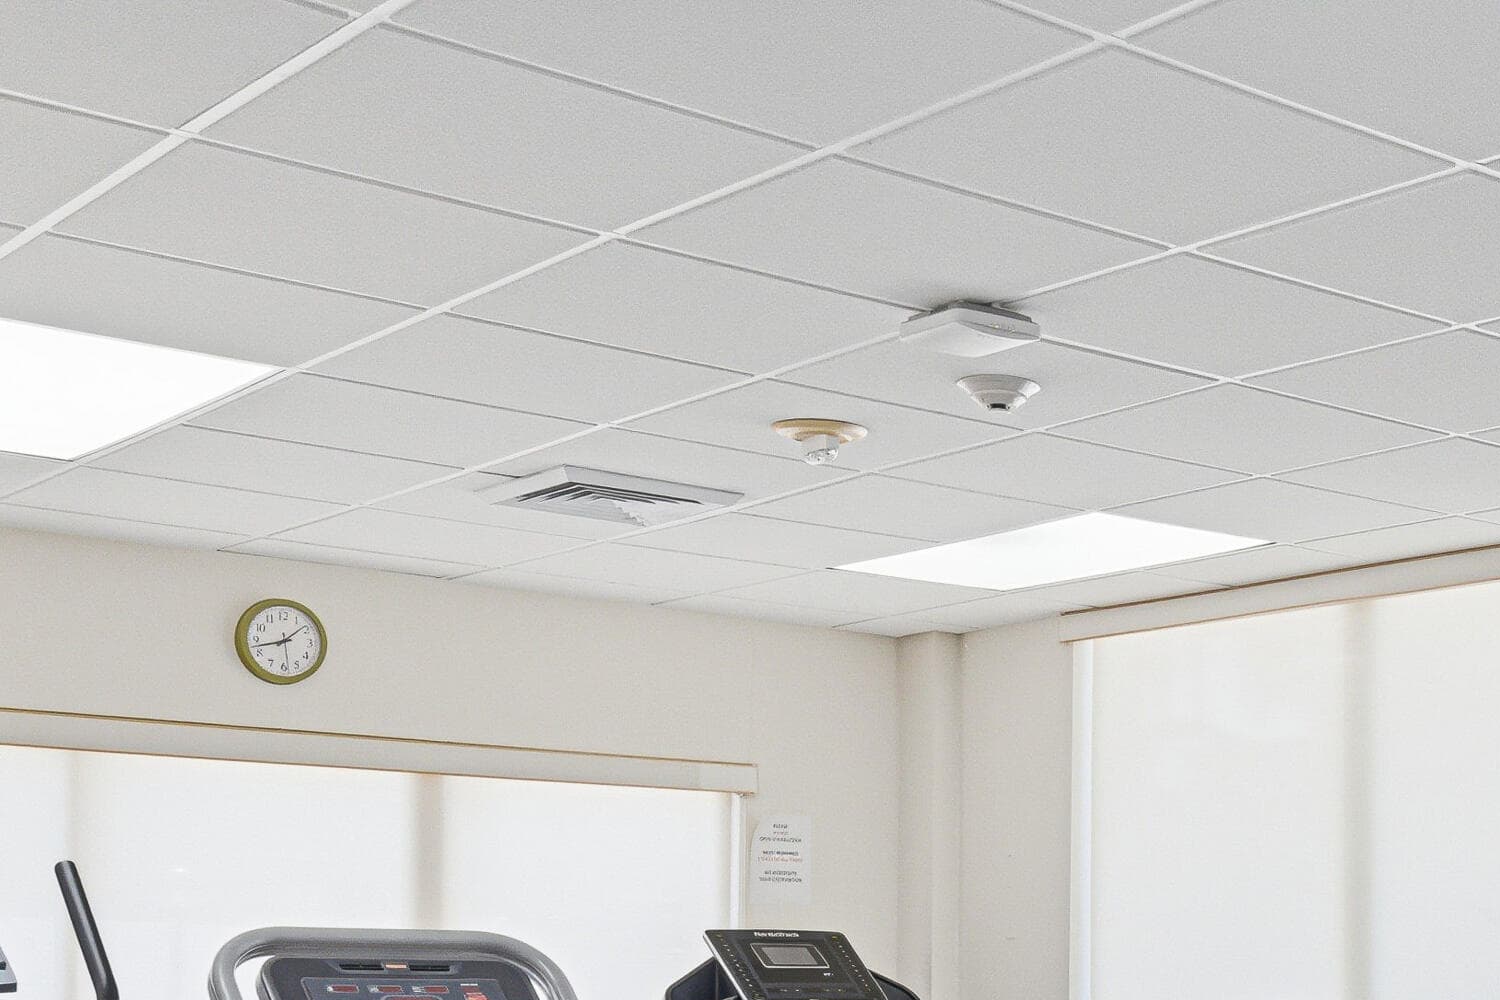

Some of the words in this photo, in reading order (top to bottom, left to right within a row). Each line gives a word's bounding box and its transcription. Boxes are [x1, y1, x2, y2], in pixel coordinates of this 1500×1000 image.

[266, 614, 274, 623] 11
[279, 611, 289, 621] 12
[295, 616, 298, 624] 1
[256, 623, 266, 632] 10
[253, 635, 260, 643] 9
[256, 648, 263, 657] 8
[268, 659, 274, 667] 7
[281, 662, 288, 671] 6
[294, 660, 300, 669] 5
